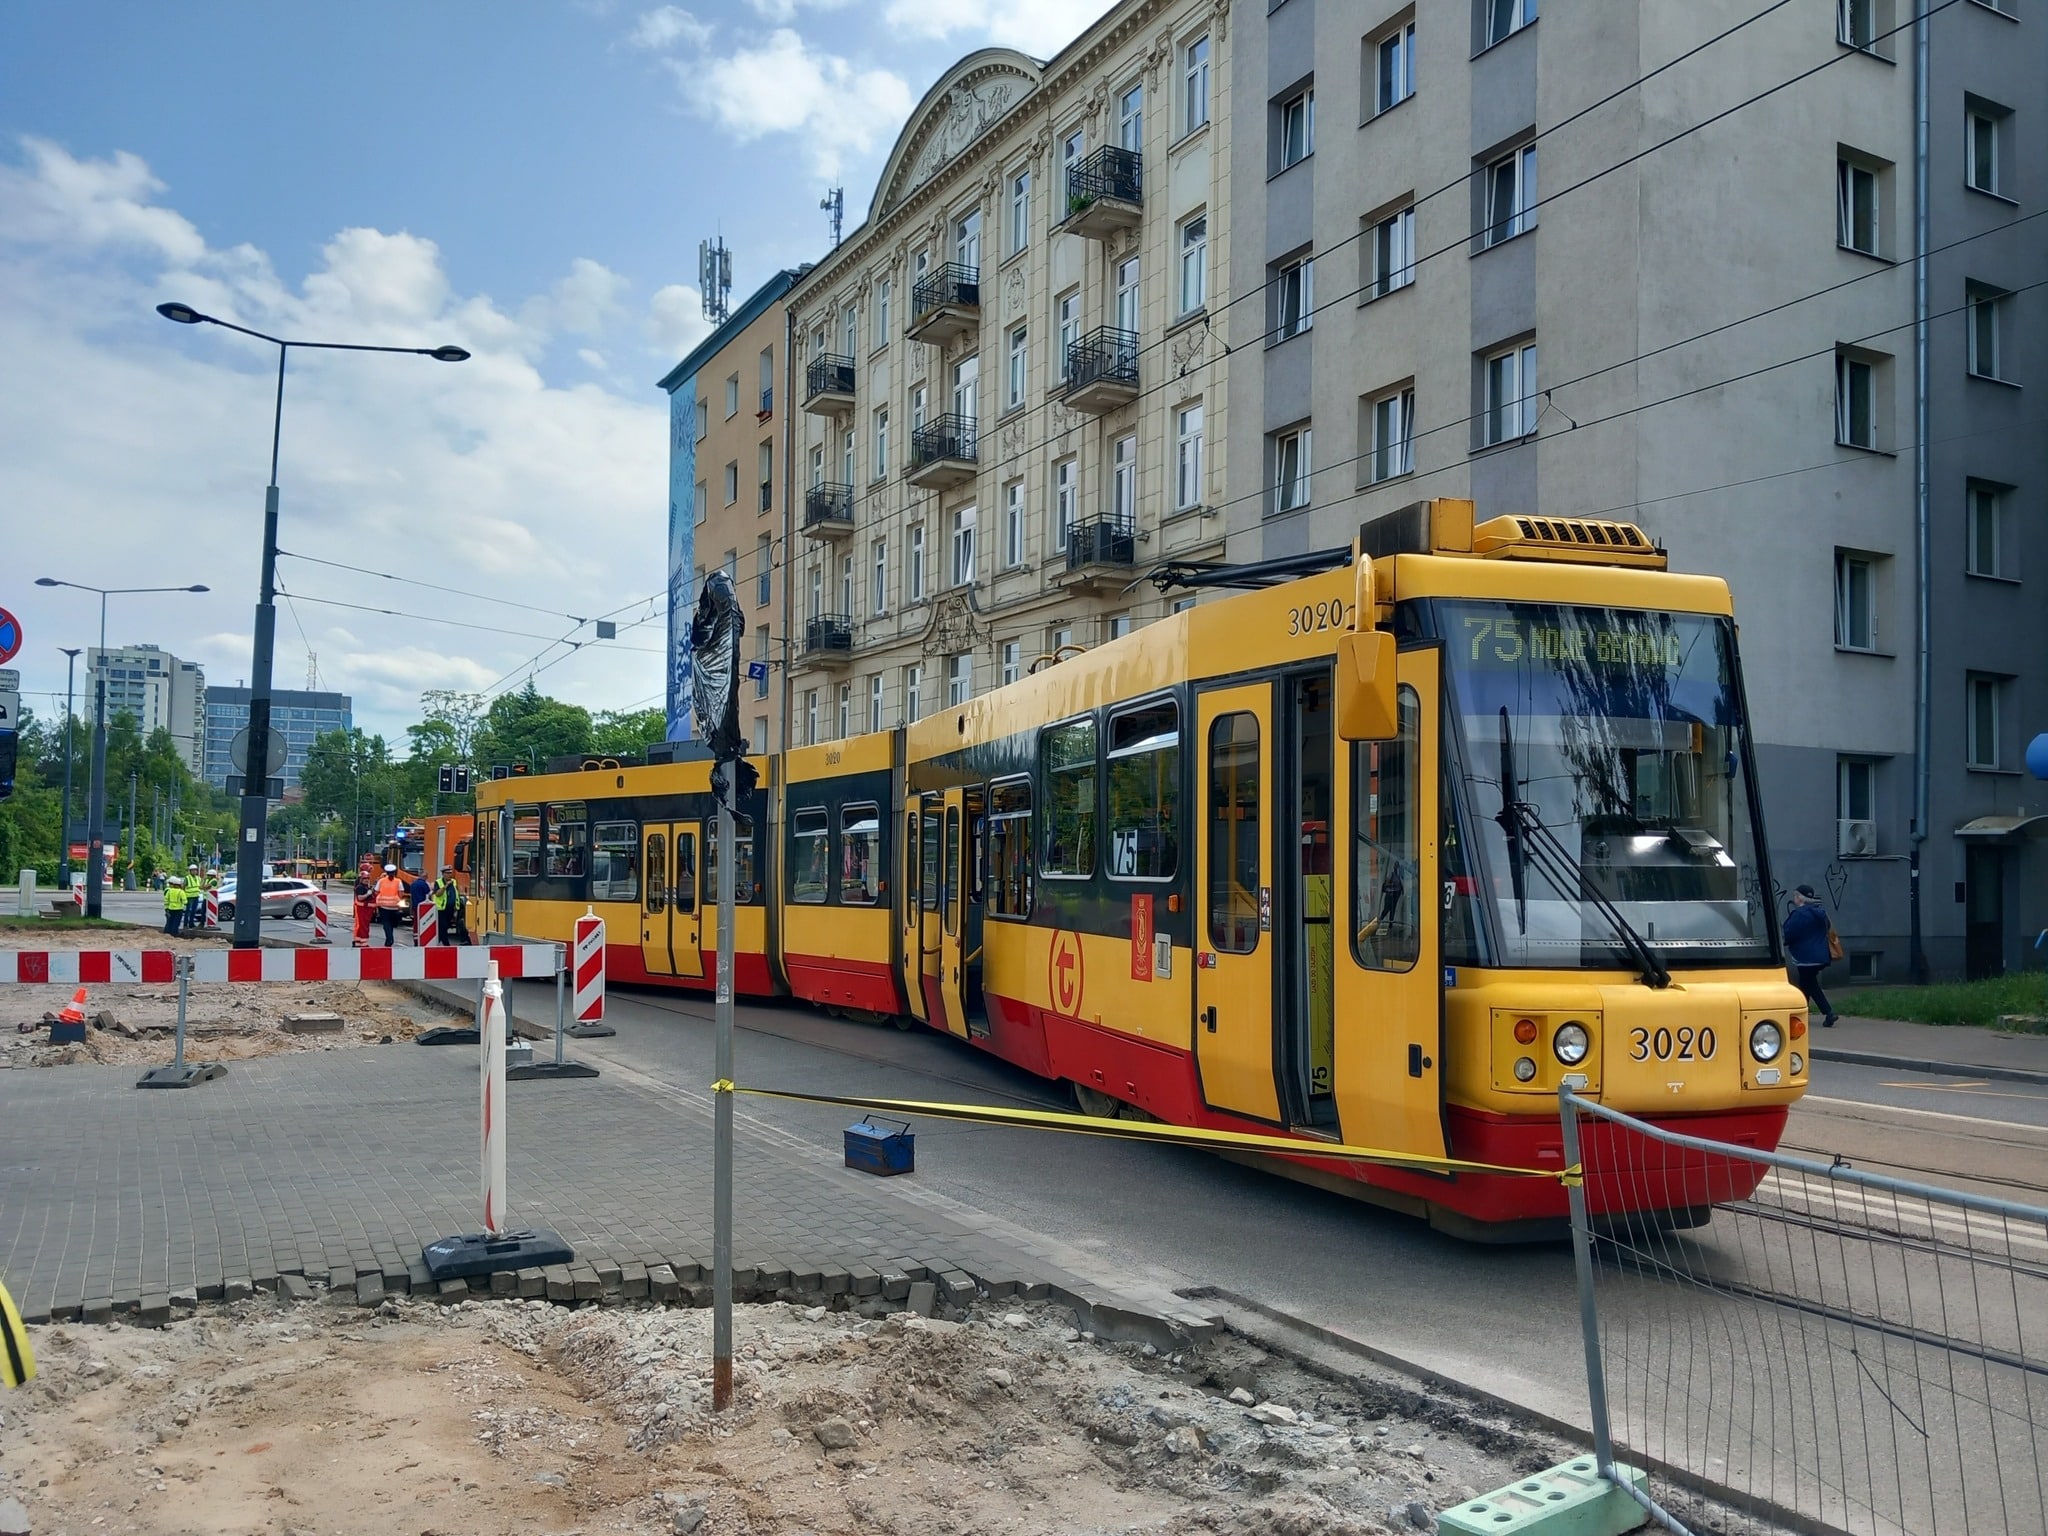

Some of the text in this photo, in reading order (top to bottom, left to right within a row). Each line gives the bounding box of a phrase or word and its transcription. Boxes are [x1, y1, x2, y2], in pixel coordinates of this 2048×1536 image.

[1287, 598, 1343, 637] 3020
[1464, 617, 1523, 662] 75
[1531, 627, 1587, 661] NOWE
[1116, 832, 1135, 874] 75
[1629, 1027, 1717, 1062] 3020
[1312, 1066, 1327, 1093] 75
